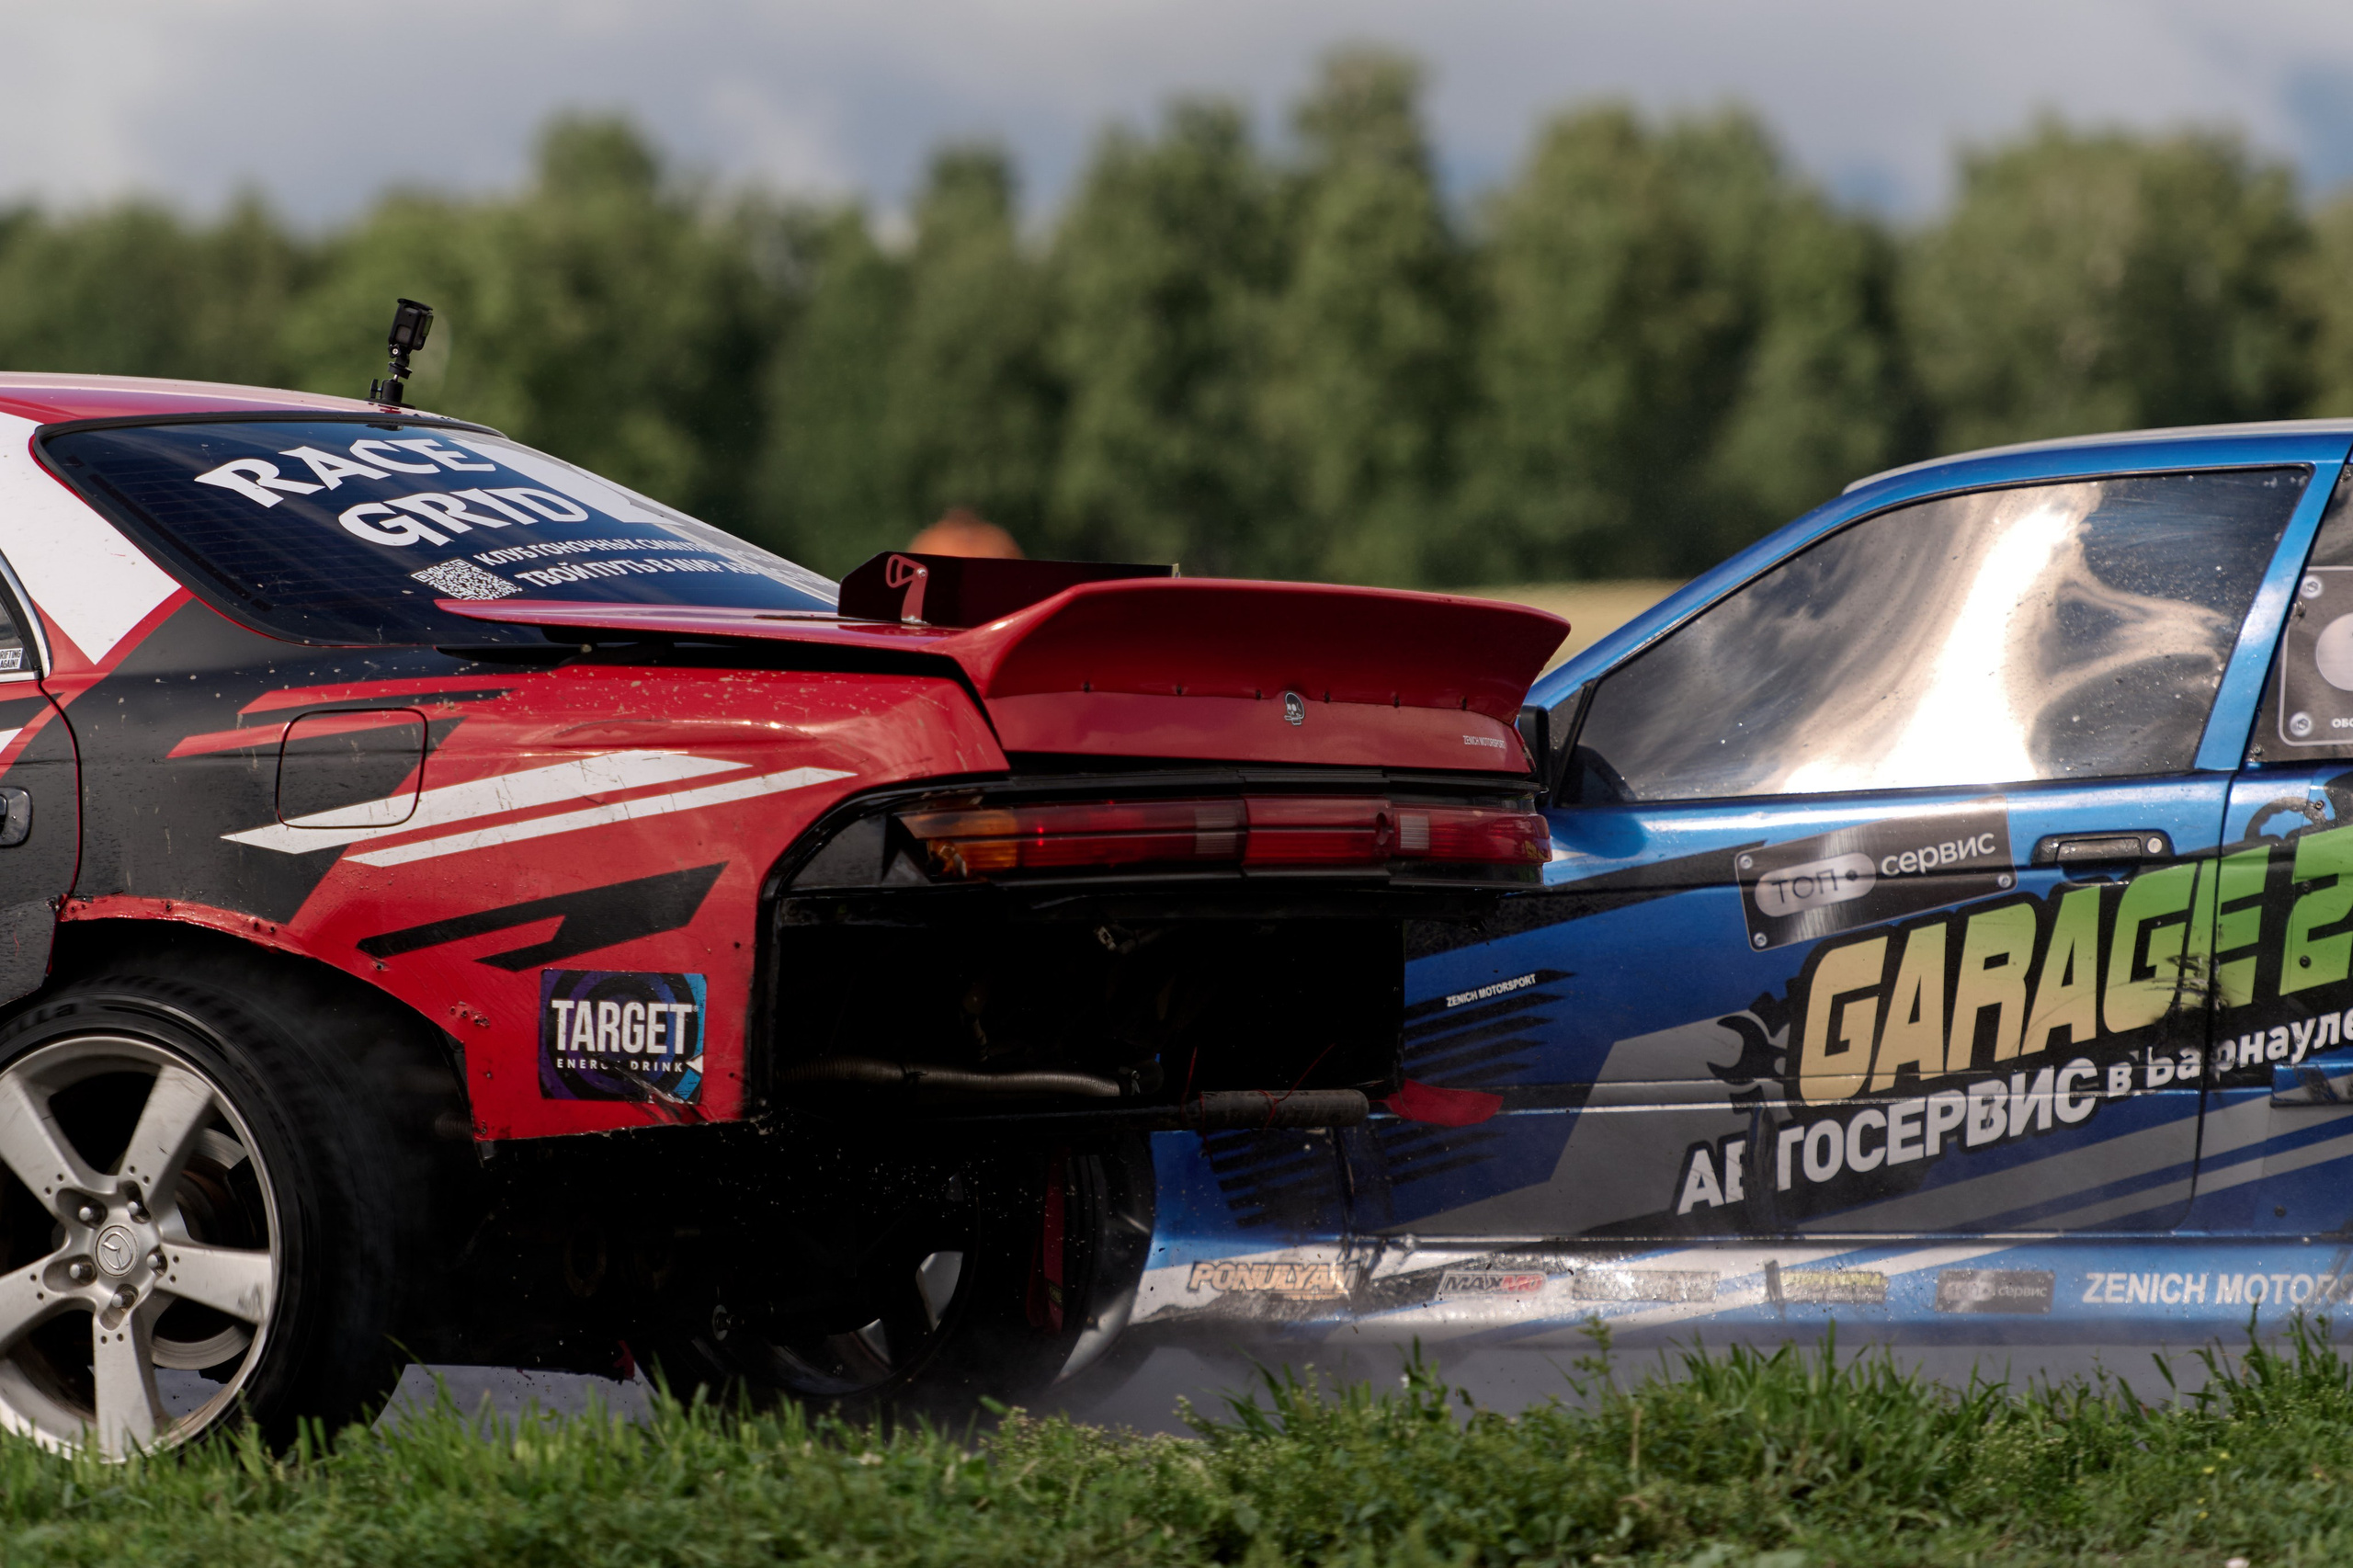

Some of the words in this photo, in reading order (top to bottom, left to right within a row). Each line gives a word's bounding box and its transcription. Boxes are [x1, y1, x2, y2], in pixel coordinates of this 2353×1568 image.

[195, 438, 497, 508] RACE
[337, 487, 589, 547] GRID
[472, 544, 539, 566] КЛУБ
[536, 539, 642, 557] ГОНОЧНЫХ
[514, 562, 590, 587] ТВОЙ
[583, 559, 658, 578] ПУТЬ
[642, 558, 676, 573] В
[661, 558, 725, 573] МИР
[1771, 869, 1839, 904] ТОП
[1881, 833, 1996, 877] сервис
[1446, 991, 1478, 1007] ZENICH
[1478, 973, 1536, 999] MOTORSPORT
[1799, 844, 2271, 1107] GARAGE
[630, 1061, 683, 1073] DRINK
[2082, 1272, 2207, 1304] ZENICH
